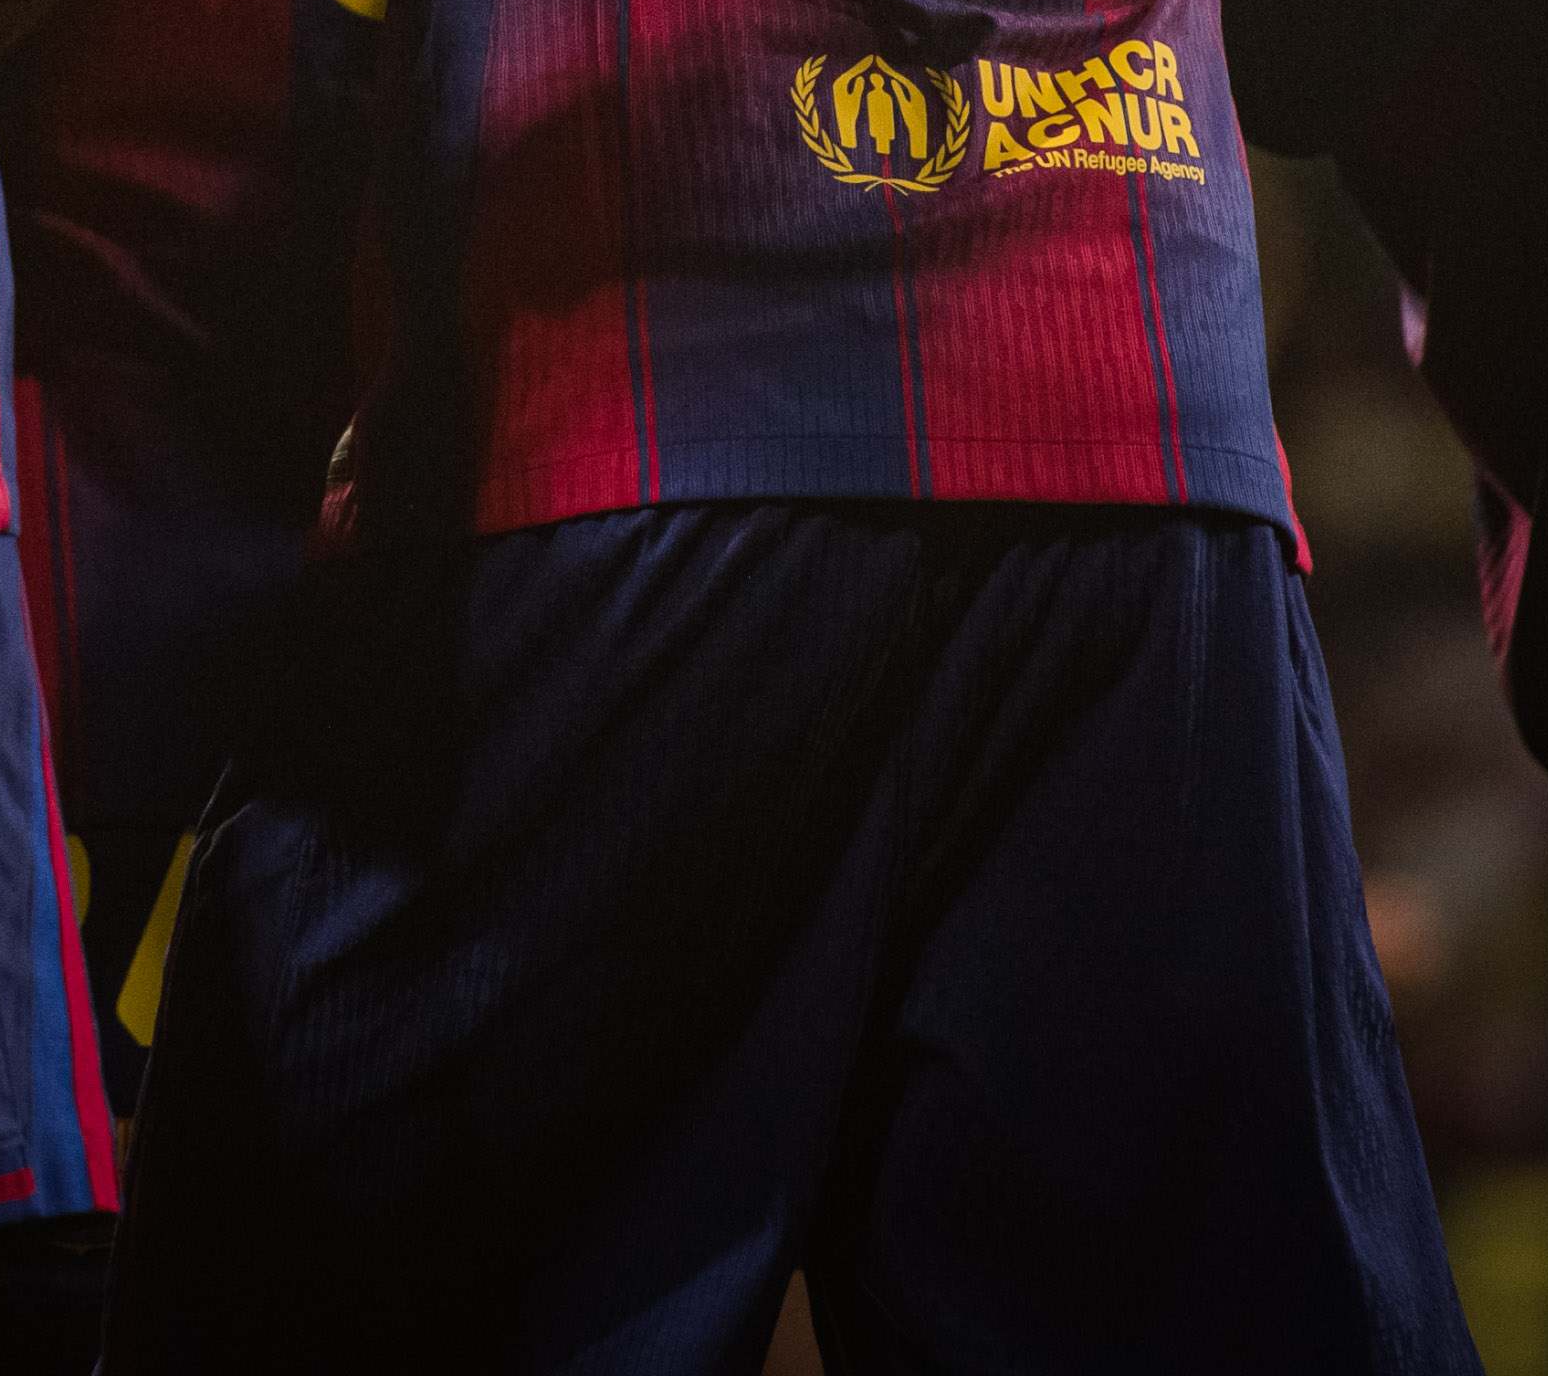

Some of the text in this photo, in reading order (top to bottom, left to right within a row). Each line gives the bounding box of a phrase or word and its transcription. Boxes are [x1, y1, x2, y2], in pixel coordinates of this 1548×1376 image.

[978, 40, 1184, 118] UNHCR
[983, 92, 1201, 171] ACNUR
[1037, 150, 1072, 169] UN
[1074, 148, 1147, 176] Refugee
[1150, 159, 1206, 186] Agency
